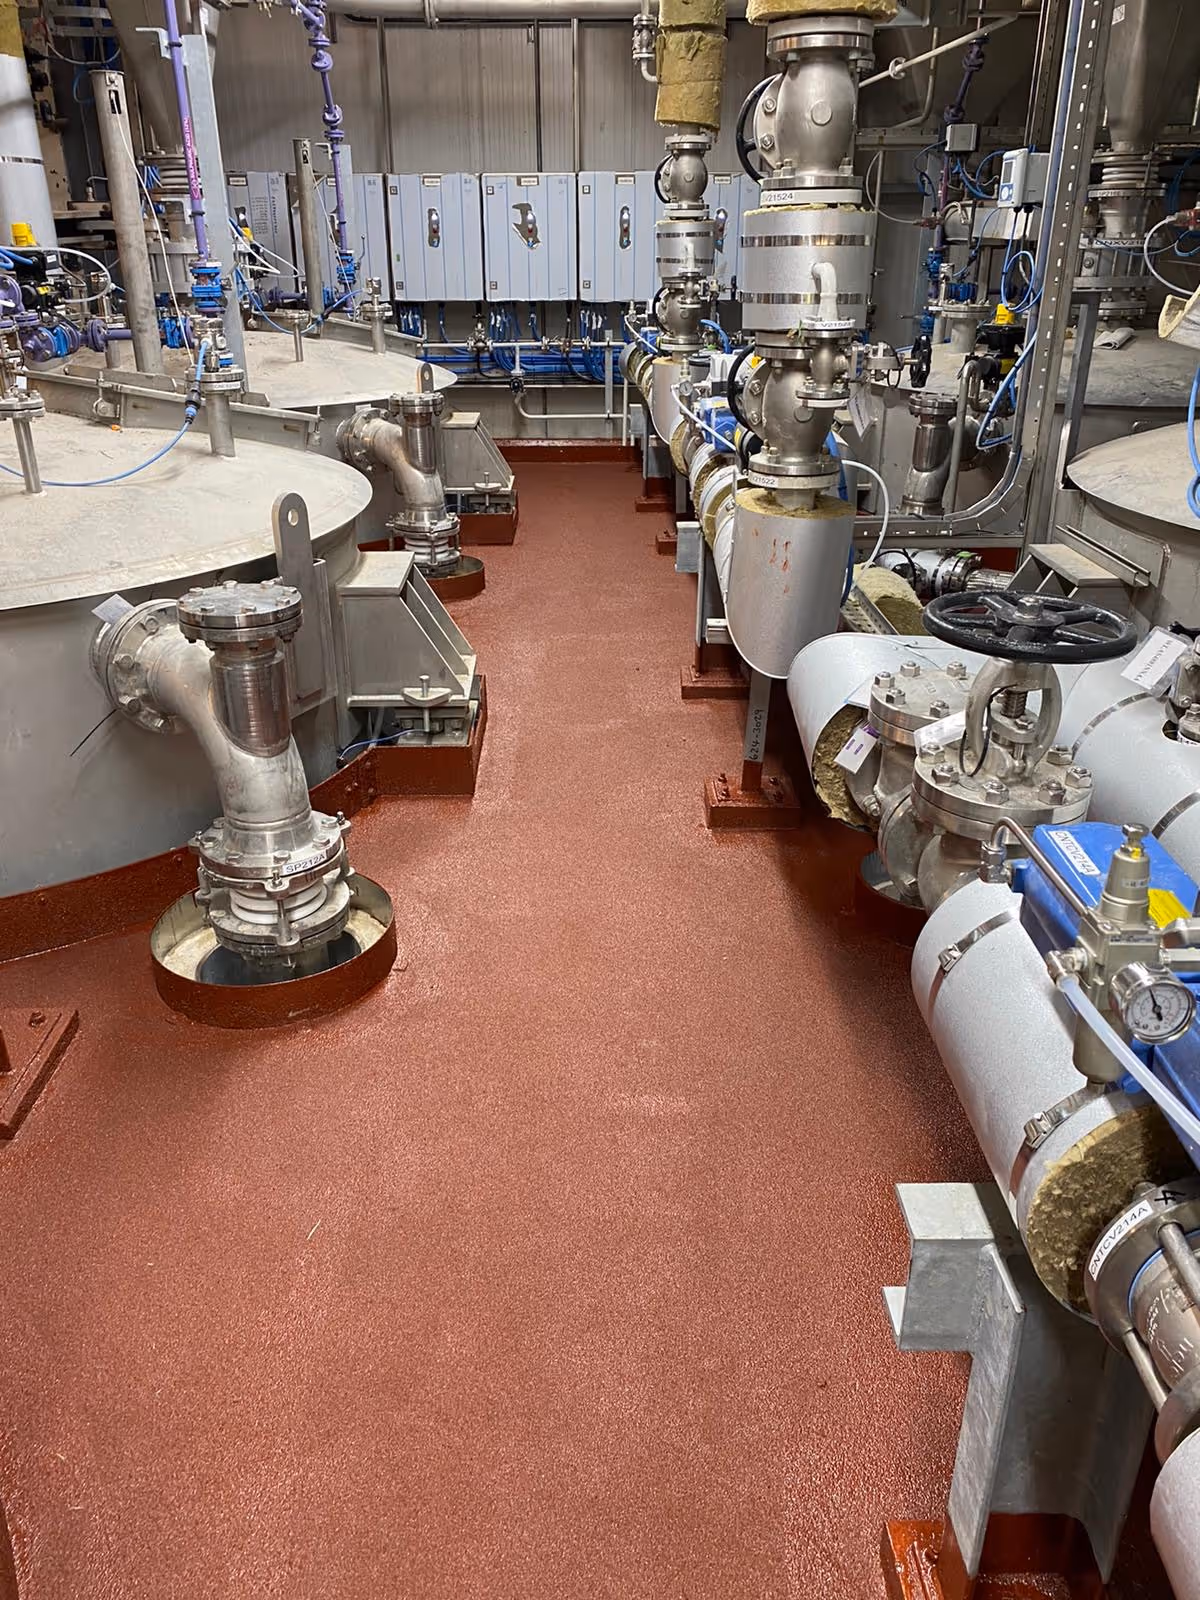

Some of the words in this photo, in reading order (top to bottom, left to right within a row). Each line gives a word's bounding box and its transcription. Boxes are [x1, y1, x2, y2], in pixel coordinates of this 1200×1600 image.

[748, 709, 766, 761] 624-3029
[285, 852, 326, 874] SP212A
[1089, 1205, 1149, 1276] CNTCV214A
